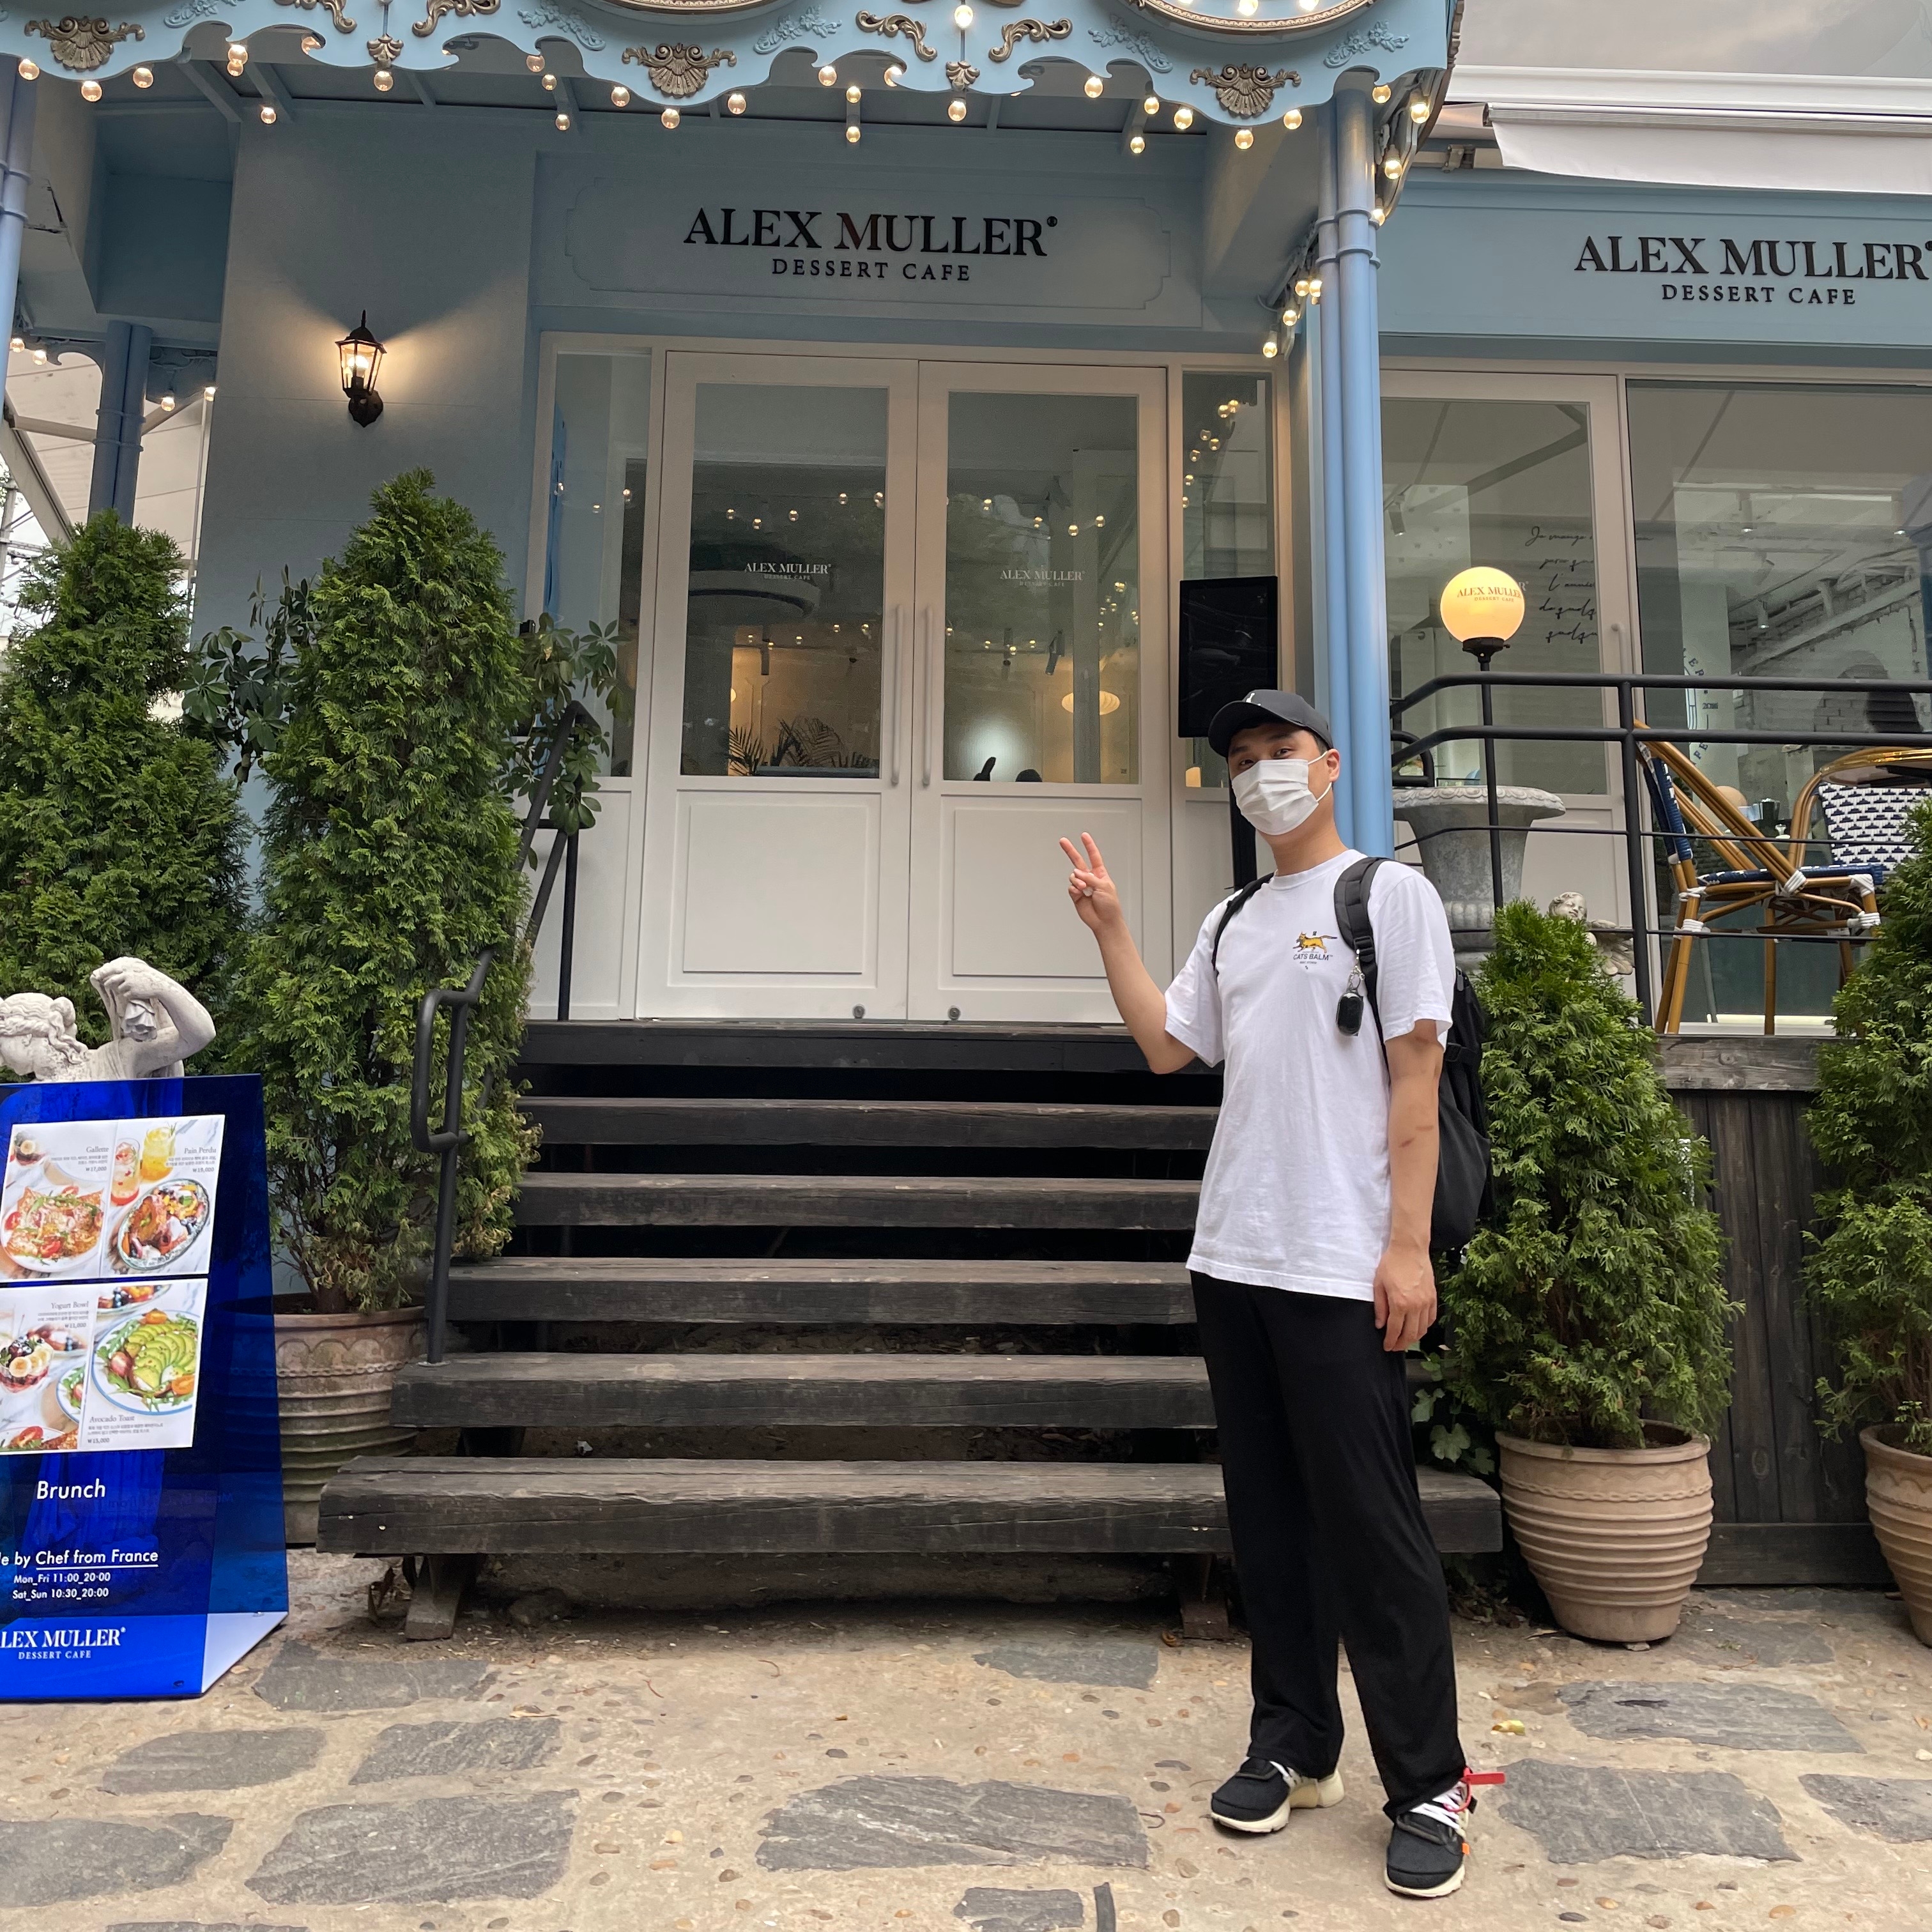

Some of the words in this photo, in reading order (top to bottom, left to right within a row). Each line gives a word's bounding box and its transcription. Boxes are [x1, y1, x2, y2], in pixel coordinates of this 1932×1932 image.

[683, 207, 822, 249] ALEX
[1574, 236, 1709, 274] ALEX
[772, 259, 889, 279] DESSERT
[903, 263, 970, 281] CAFE
[1662, 284, 1775, 302] DESSERT
[1789, 288, 1855, 305] CAFE
[744, 562, 776, 572] ALEX
[1000, 569, 1031, 579] ALEX
[1457, 587, 1485, 597] ALEX
[37, 1478, 105, 1499] Brunch
[14, 1551, 31, 1568] by
[36, 1550, 70, 1565] Chef
[73, 1549, 105, 1564] from
[111, 1549, 158, 1563] France
[0, 1630, 39, 1648] LEX
[18, 1651, 61, 1660] DESSERT
[65, 1650, 91, 1659] CAFE
